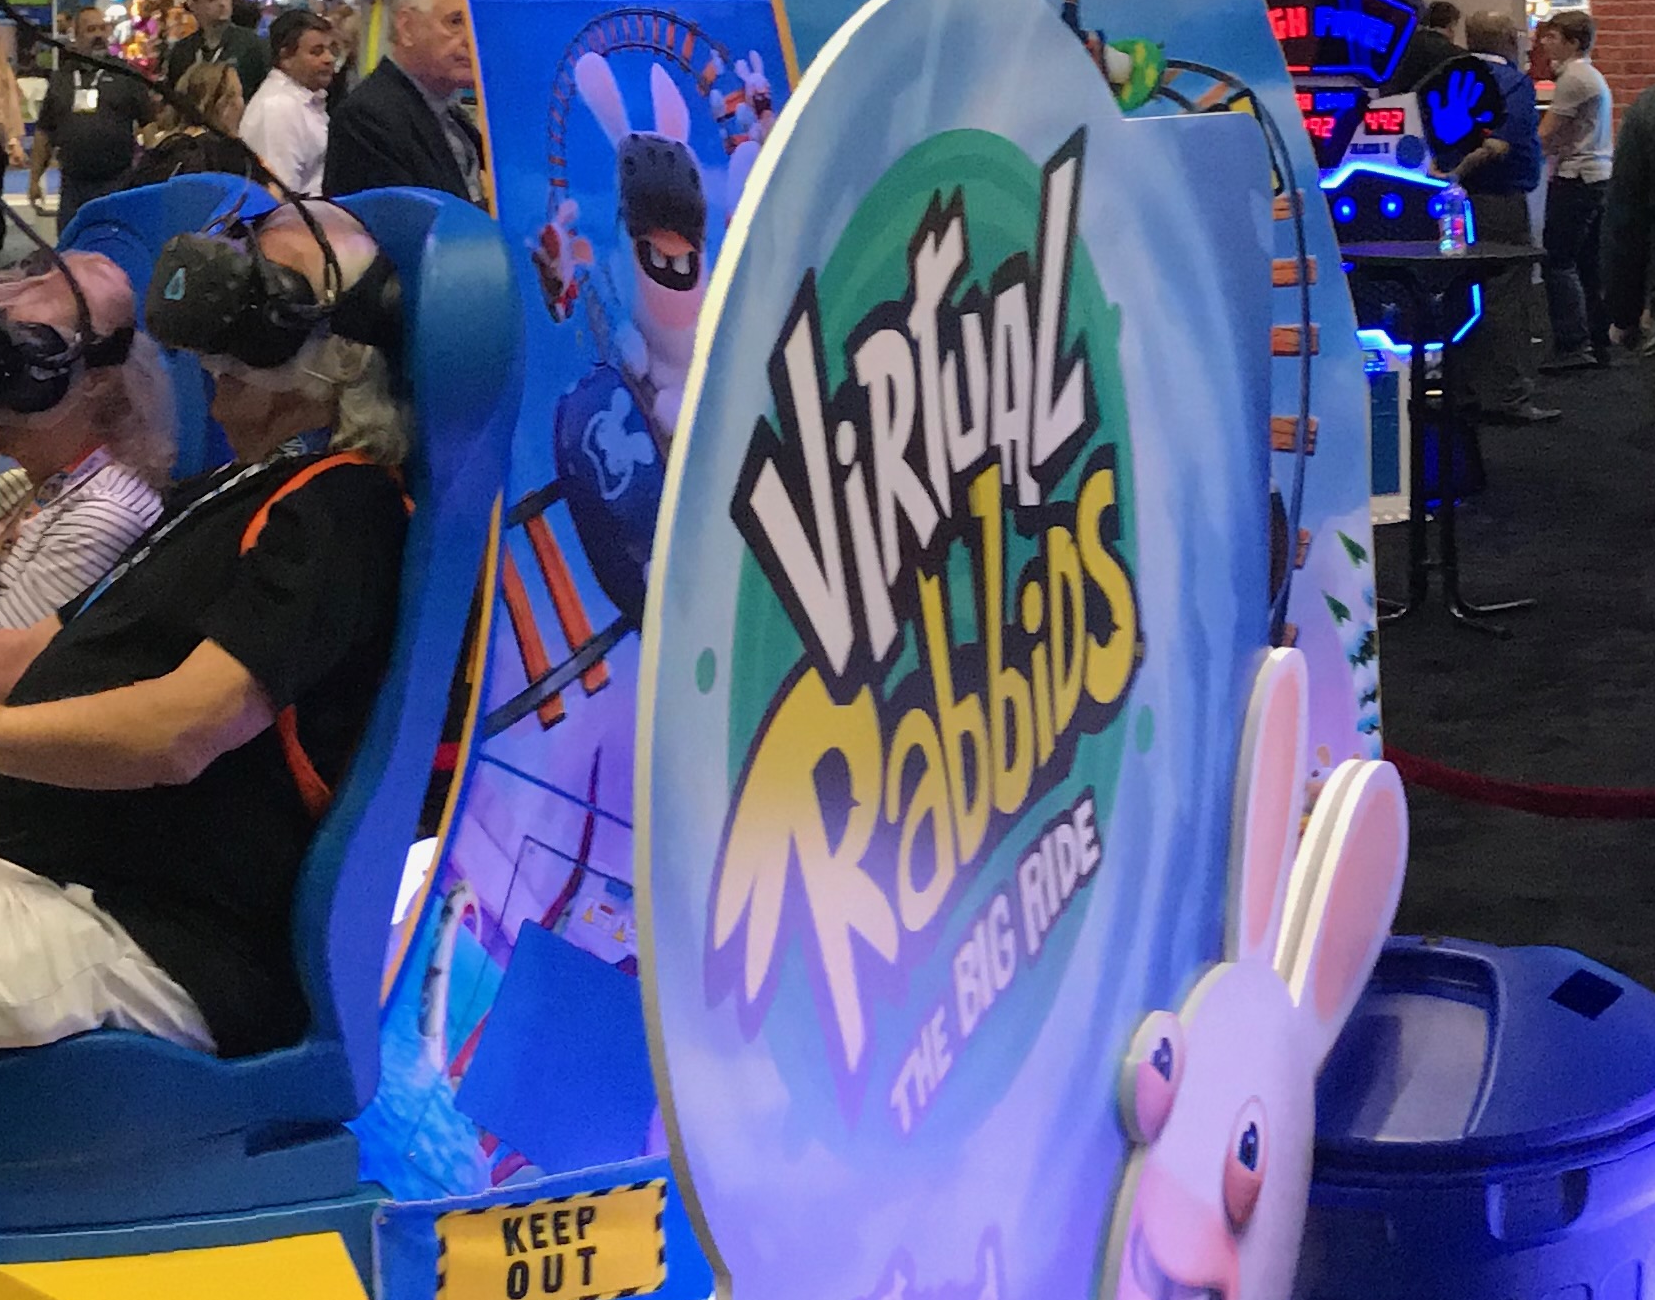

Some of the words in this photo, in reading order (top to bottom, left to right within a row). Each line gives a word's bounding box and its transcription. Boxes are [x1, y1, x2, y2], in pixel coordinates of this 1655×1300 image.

[1365, 111, 1404, 131] 492
[890, 1006, 953, 1135] THE
[953, 893, 1016, 1035] BIG
[1018, 798, 1102, 957] RIDE
[502, 1205, 596, 1256] KEEP
[506, 1246, 597, 1300] OUT
